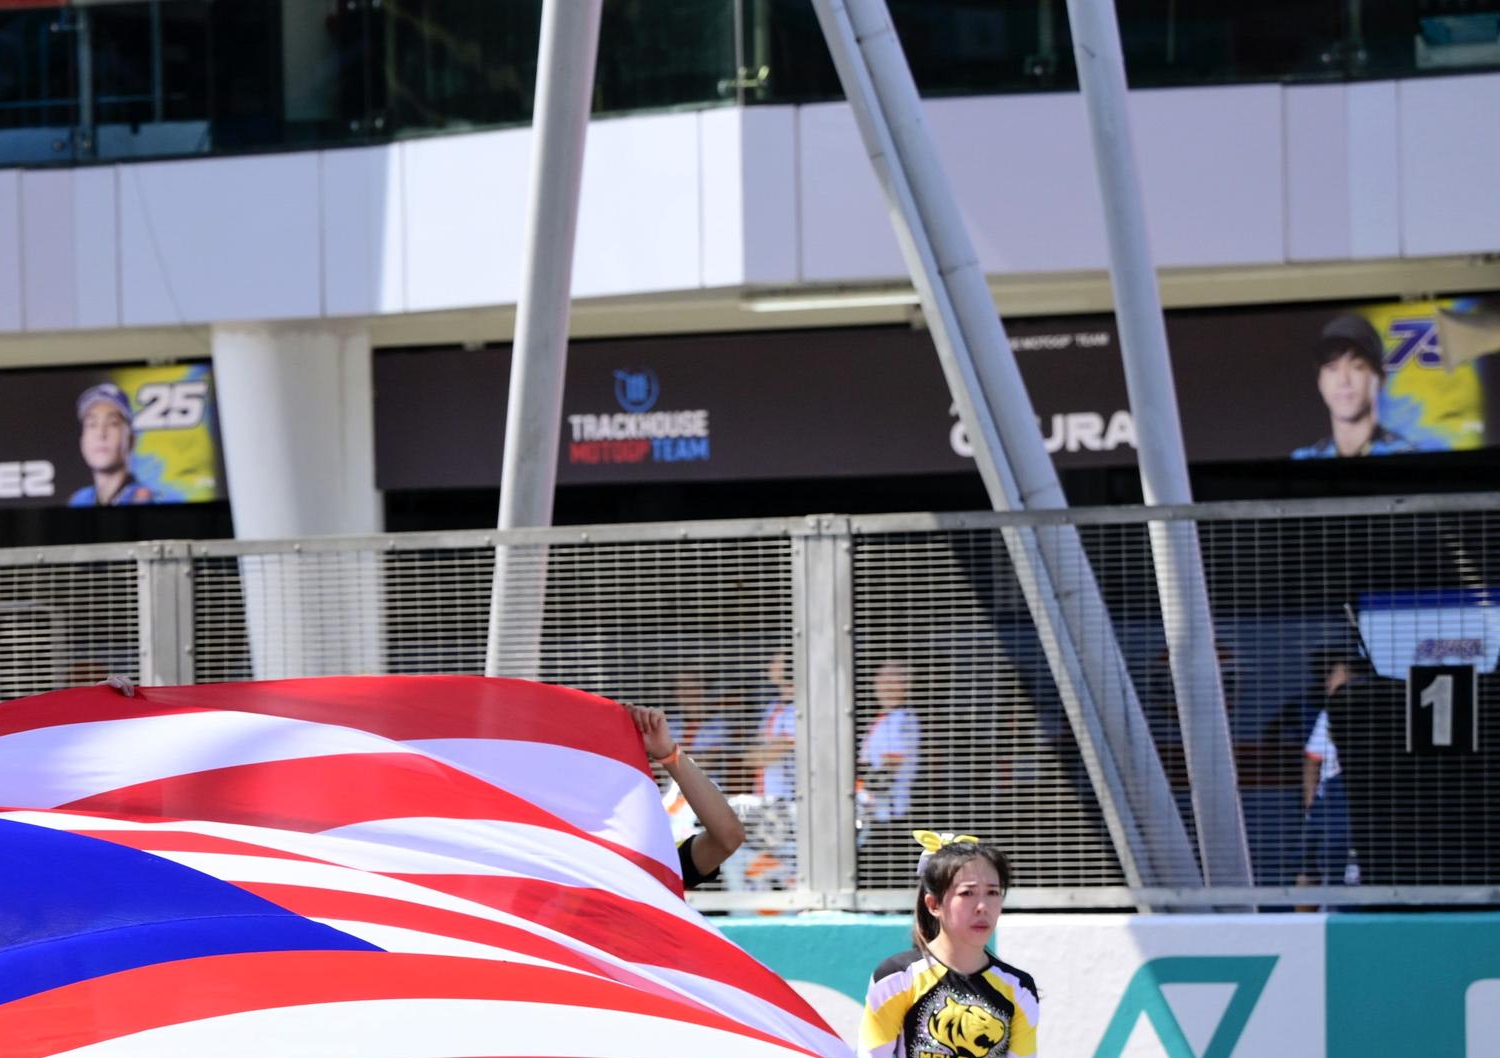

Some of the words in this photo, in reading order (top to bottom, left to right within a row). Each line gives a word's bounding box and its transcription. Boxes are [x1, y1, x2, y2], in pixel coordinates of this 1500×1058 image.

[132, 383, 208, 430] 25
[568, 410, 709, 441] TRACKHOUSE
[652, 436, 710, 462] TEAM
[1420, 674, 1453, 746] 1
